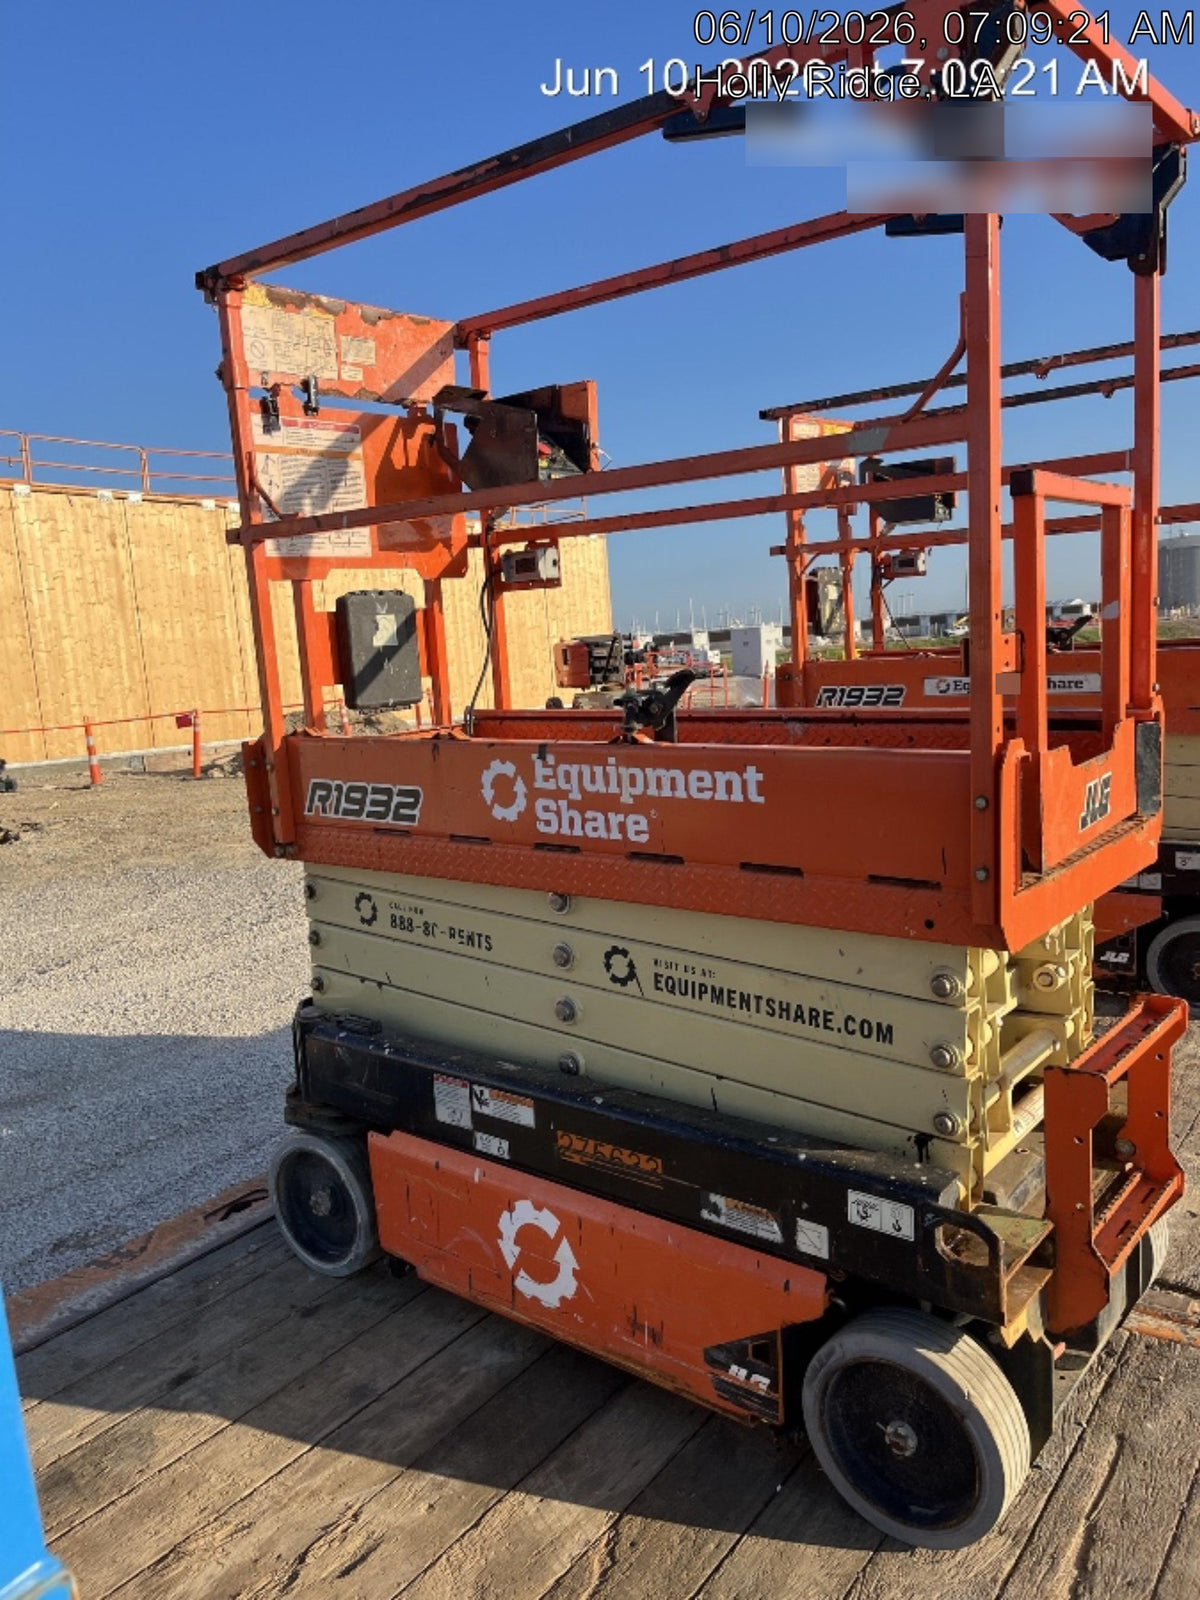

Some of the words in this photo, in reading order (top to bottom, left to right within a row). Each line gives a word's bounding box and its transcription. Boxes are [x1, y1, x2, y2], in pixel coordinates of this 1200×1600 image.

[815, 684, 906, 708] R1932
[304, 777, 424, 827] R1932
[532, 753, 766, 804] Equipment
[535, 797, 651, 843] Share
[1100, 951, 1130, 964] JLG
[653, 972, 894, 1045] EQUIPMENTSHARE.COM
